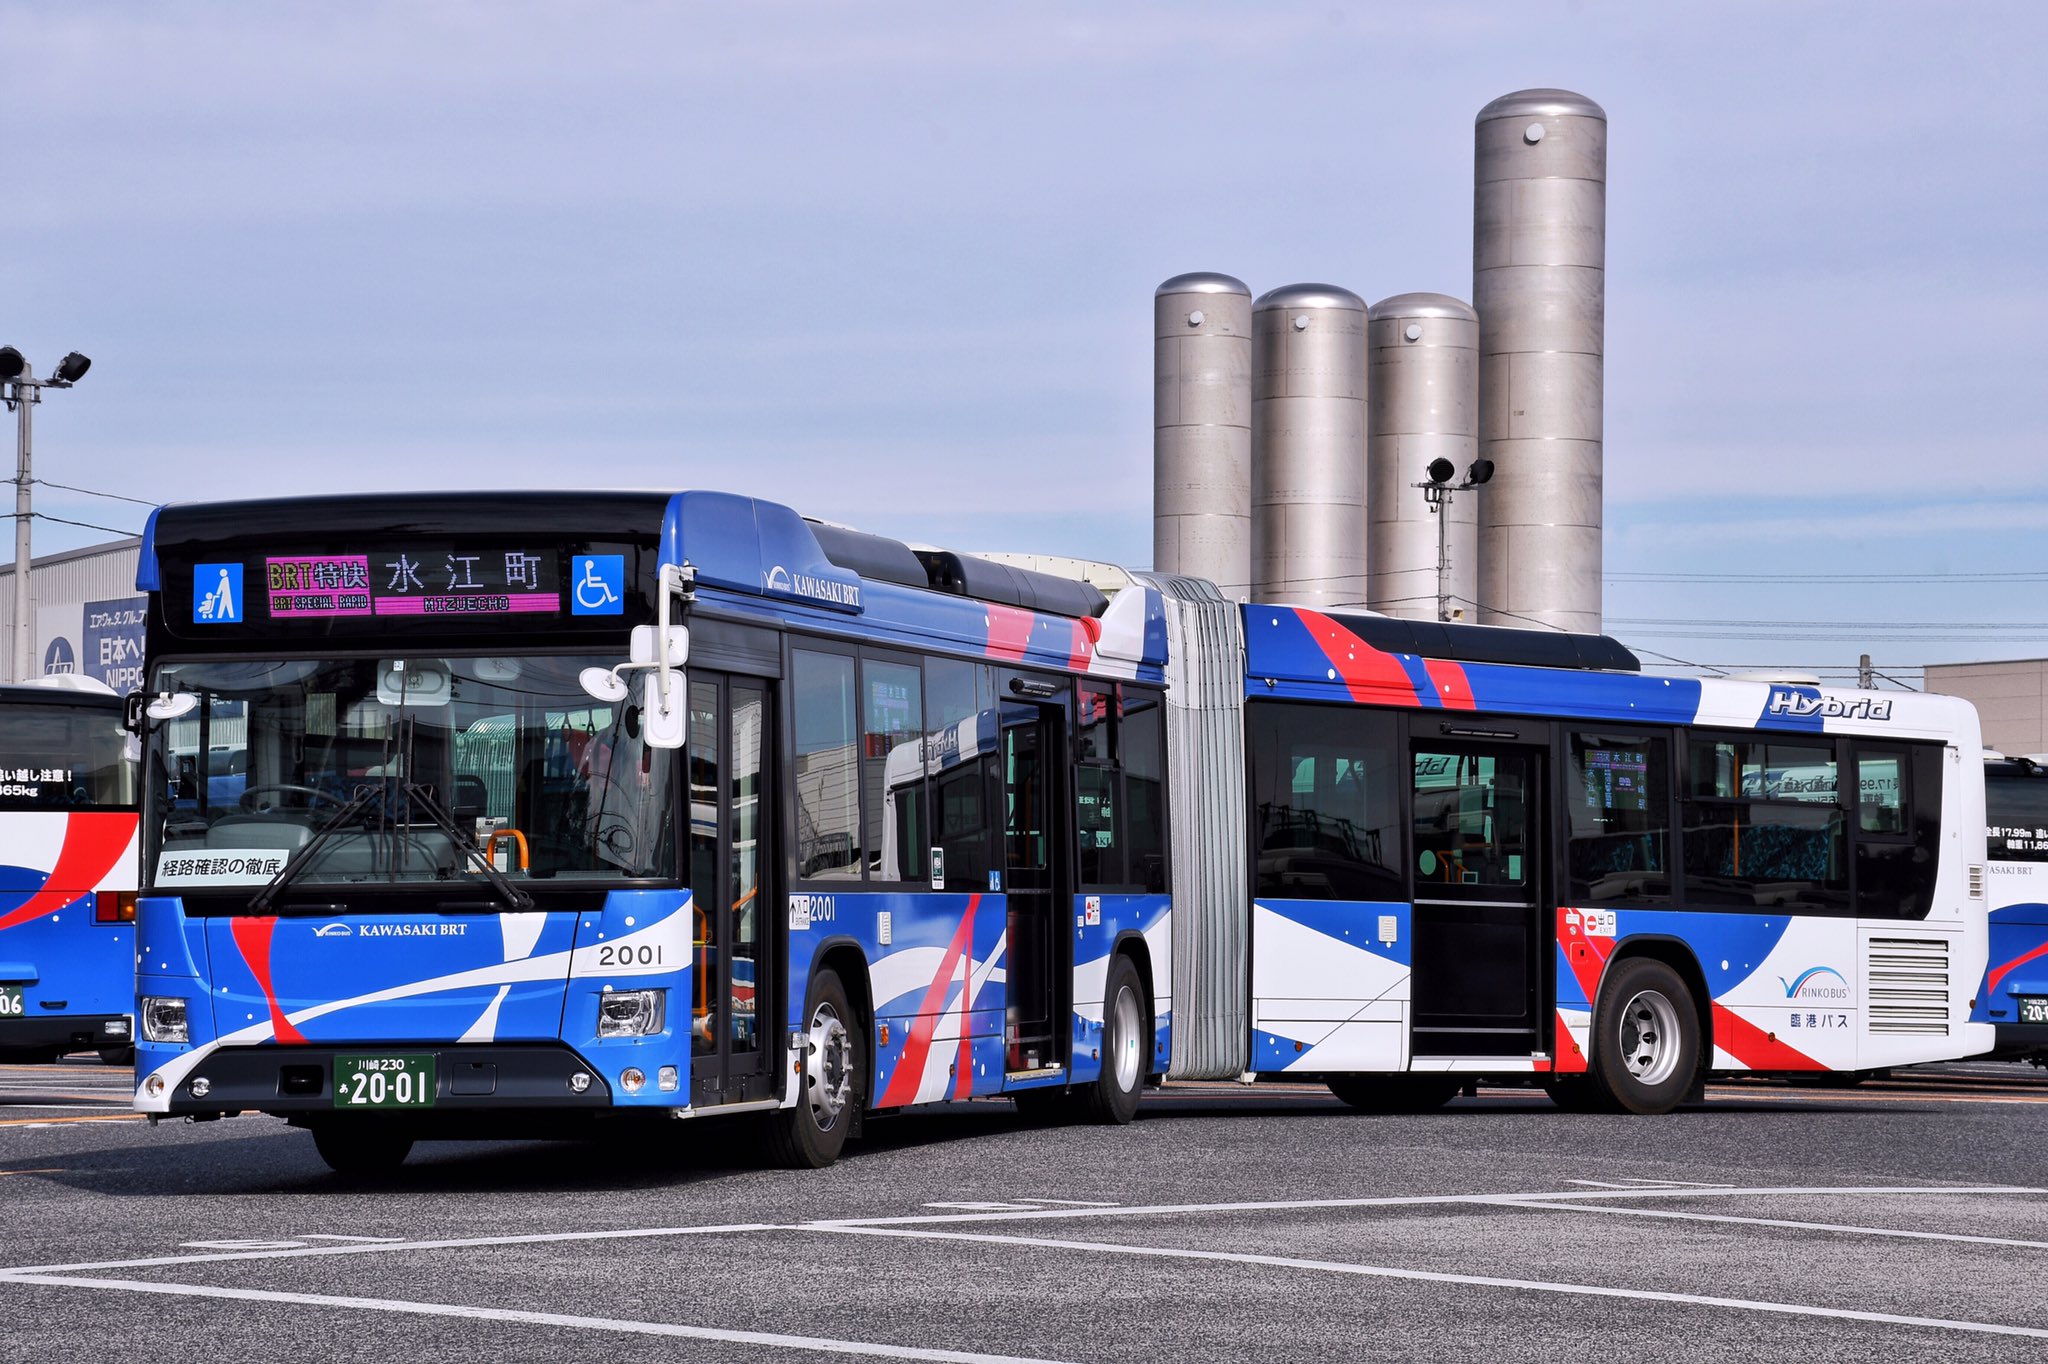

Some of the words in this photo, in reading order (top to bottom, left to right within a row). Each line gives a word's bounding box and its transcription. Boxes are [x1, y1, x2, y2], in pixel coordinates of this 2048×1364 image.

[386, 554, 541, 592] 水江町
[793, 573, 842, 603] KAWASAKI
[843, 584, 860, 606] BRT
[273, 596, 292, 610] BRT
[294, 595, 335, 609] SPECIAL
[339, 594, 367, 608] RAPID
[424, 597, 509, 612] MIZUECHO
[1769, 691, 1892, 721] Hybrid
[0, 785, 38, 797] 65kg
[162, 858, 281, 877] 経路確認の徹底
[1988, 866, 2015, 875] ASAKI
[2017, 867, 2032, 875] BRT
[797, 900, 808, 914] 入口
[811, 896, 835, 921] 2001
[1598, 914, 1614, 925] 出口
[359, 924, 437, 937] KAWASAKI
[440, 924, 468, 936] BRT
[599, 945, 662, 966] 2001
[1802, 987, 1830, 998] RINKO
[1830, 988, 1847, 998] BUS
[1790, 1014, 1848, 1028] 臨港バス
[339, 1083, 349, 1094] あ
[351, 1072, 425, 1104] 20-01
